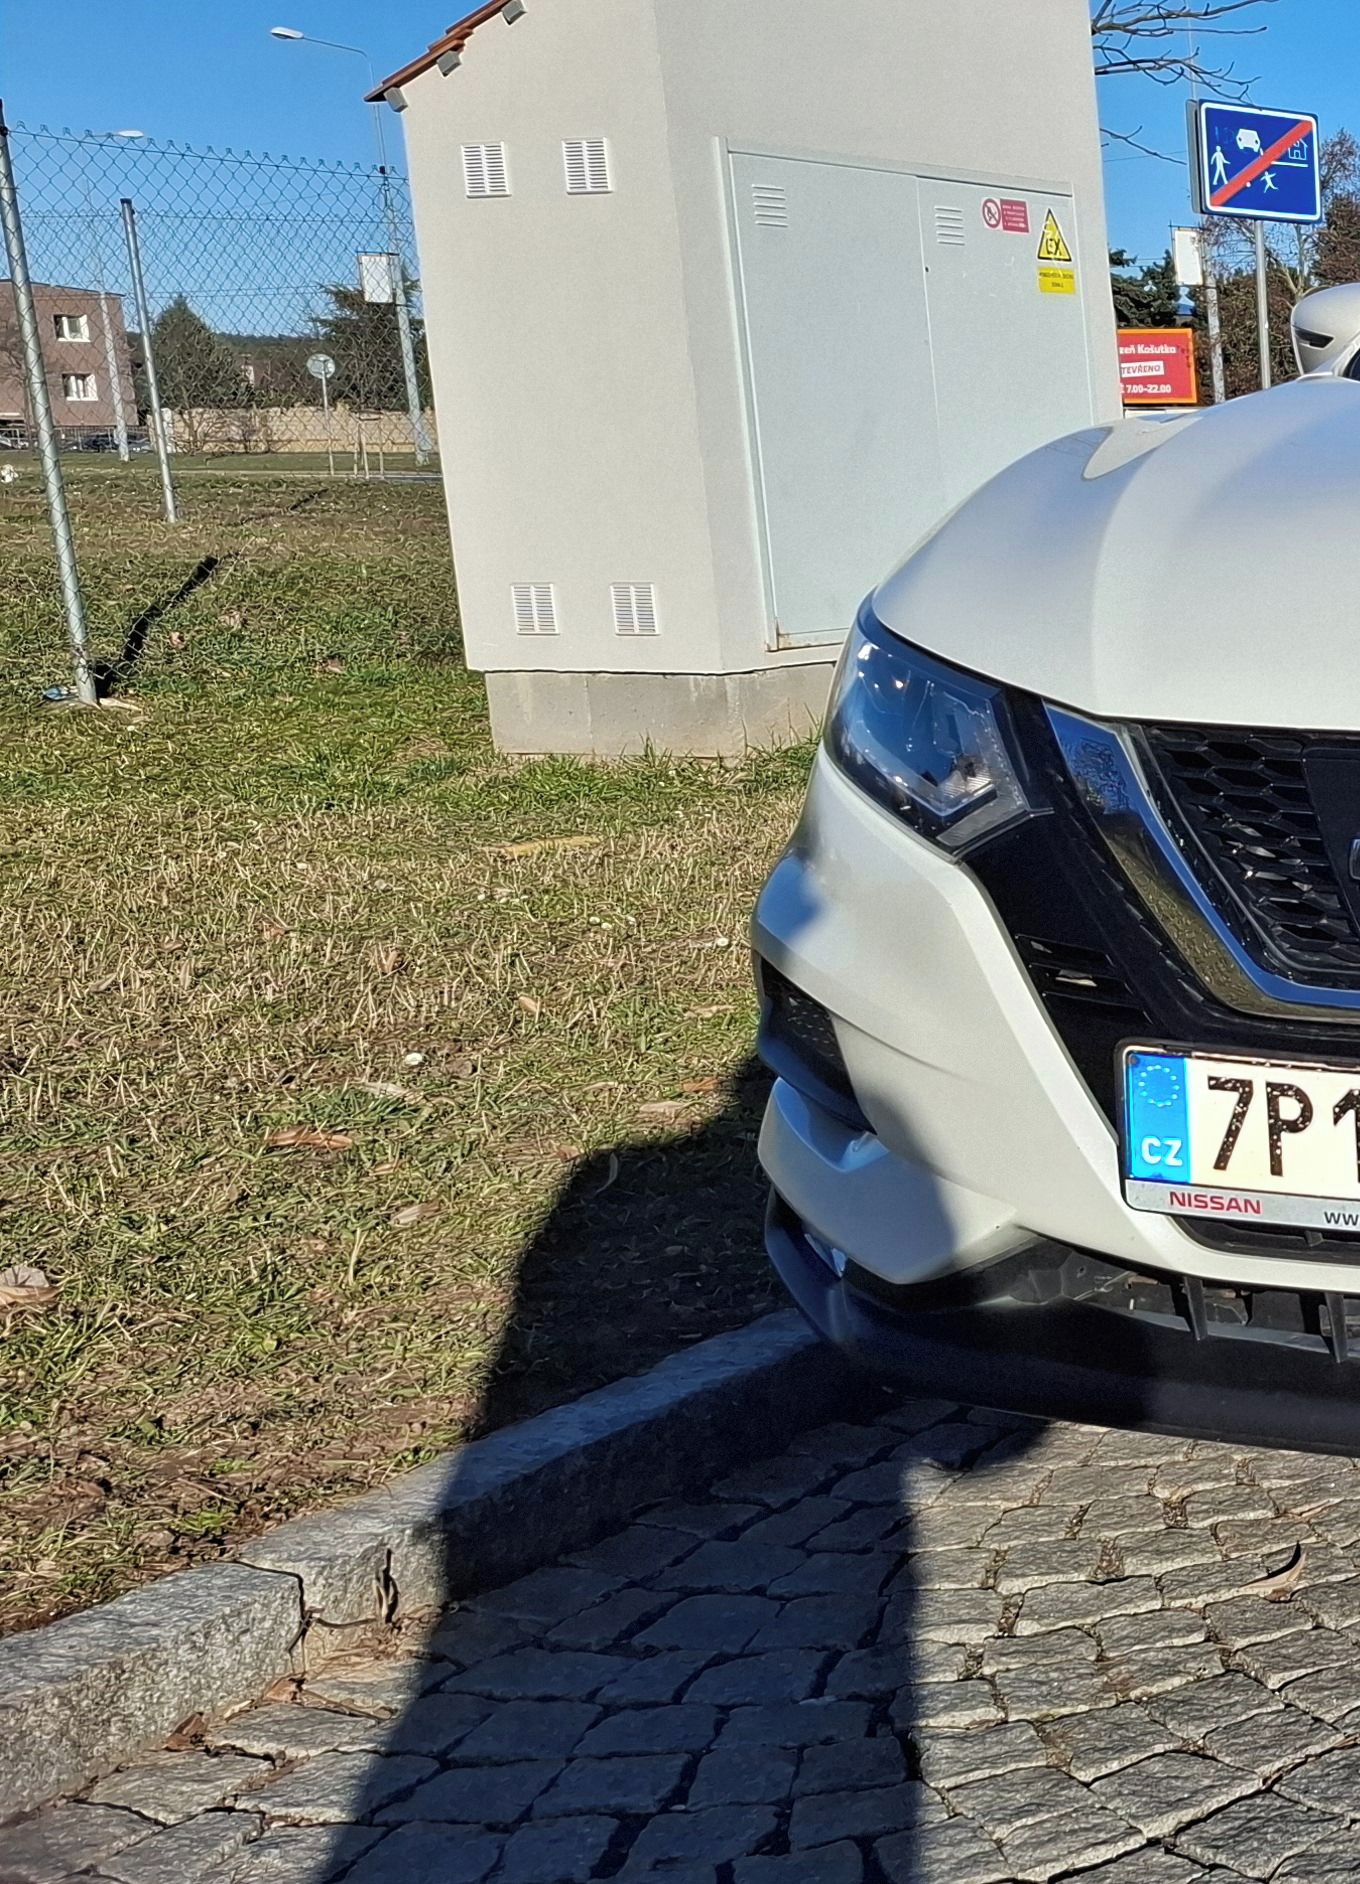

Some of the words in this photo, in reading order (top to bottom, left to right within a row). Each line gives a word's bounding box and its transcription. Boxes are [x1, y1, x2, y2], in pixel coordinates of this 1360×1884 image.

[1119, 345, 1136, 354] zeň
[1121, 364, 1161, 375] TEVŘENO
[1141, 1135, 1183, 1167] CZ
[1169, 1190, 1262, 1215] NISSAN
